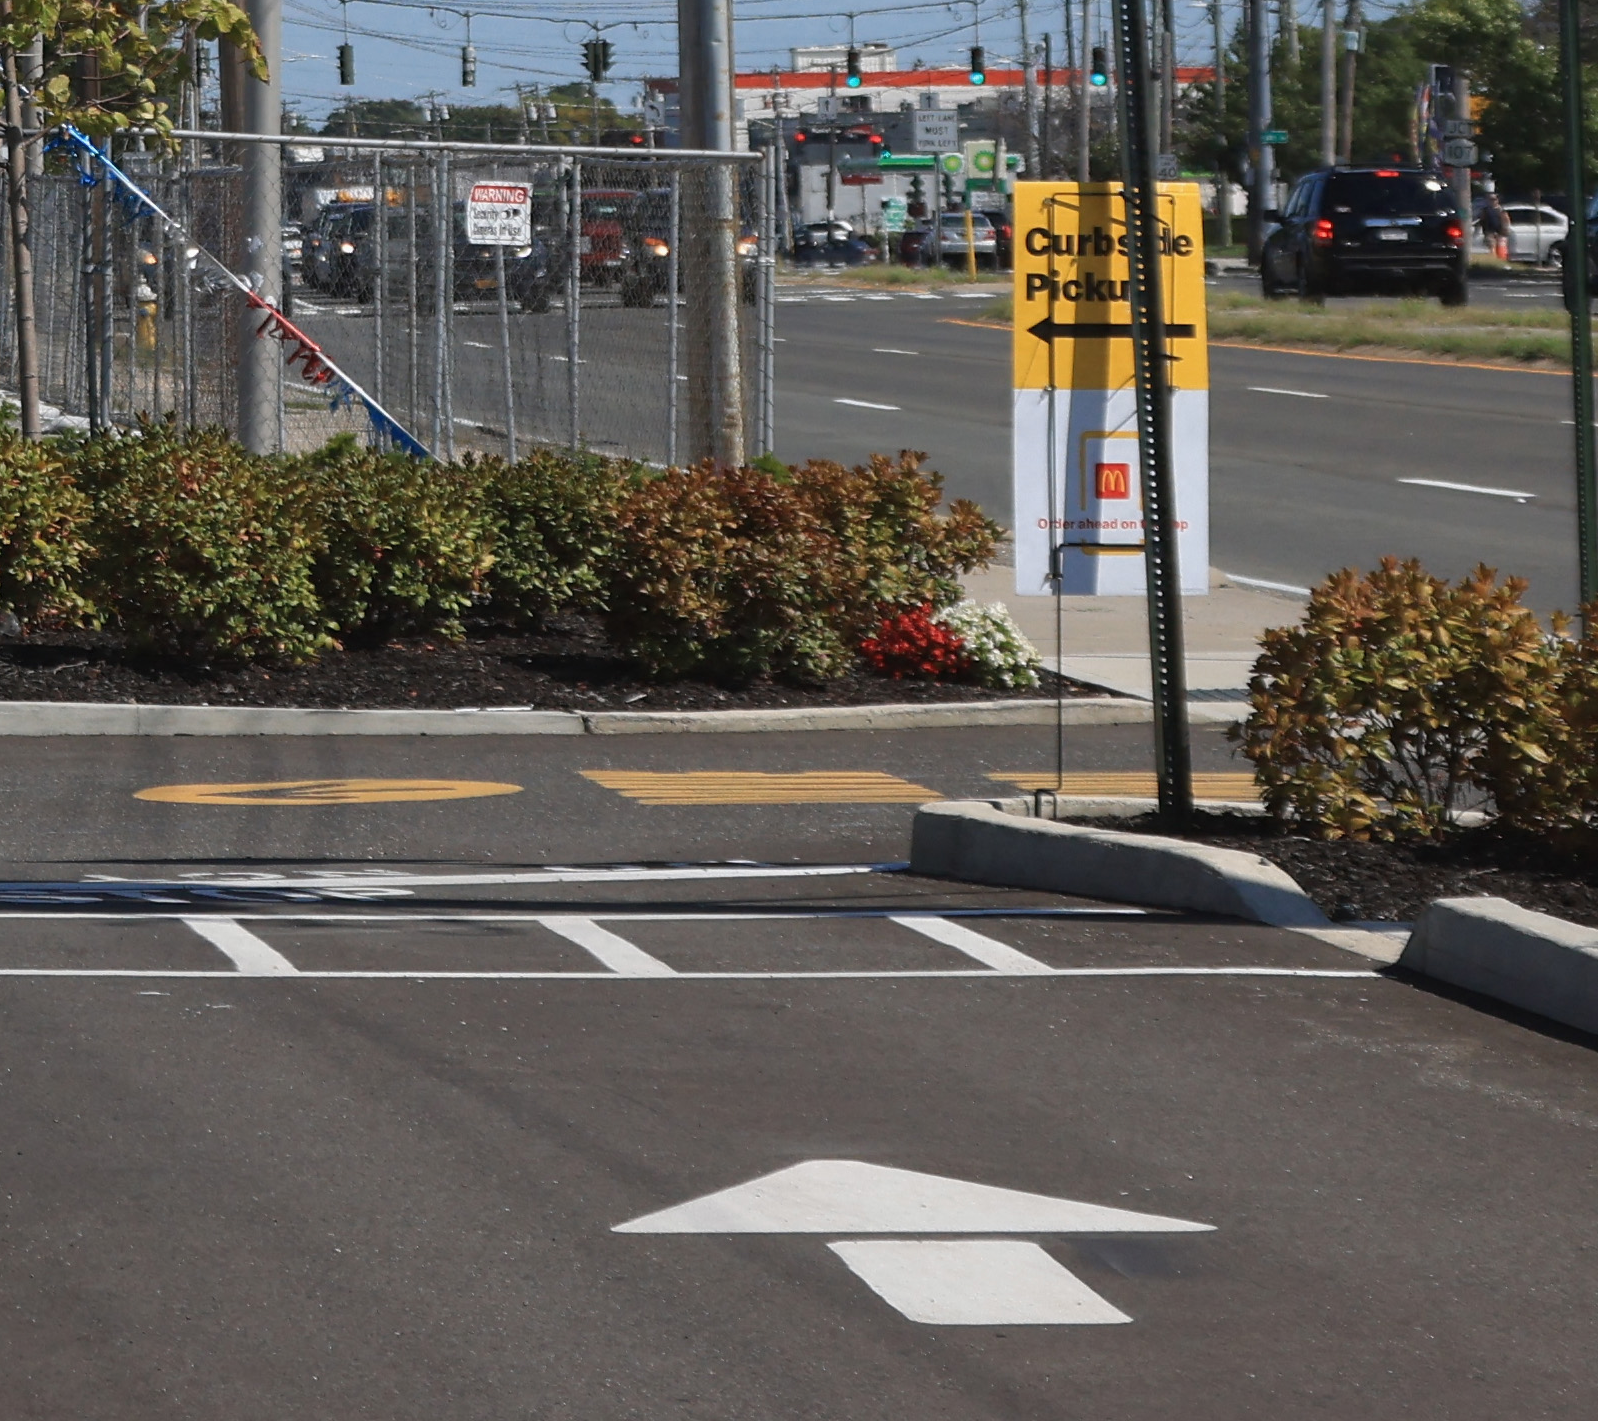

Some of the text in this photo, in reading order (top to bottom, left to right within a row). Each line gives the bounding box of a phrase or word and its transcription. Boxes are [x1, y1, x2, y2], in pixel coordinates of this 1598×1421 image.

[925, 126, 949, 135] MUST
[474, 188, 525, 203] WARNING
[1025, 226, 1194, 257] Curbsde
[1026, 269, 1130, 302] Picku
[1037, 518, 1075, 530] Order
[1078, 518, 1118, 530] ahead
[1120, 520, 1137, 530] on
